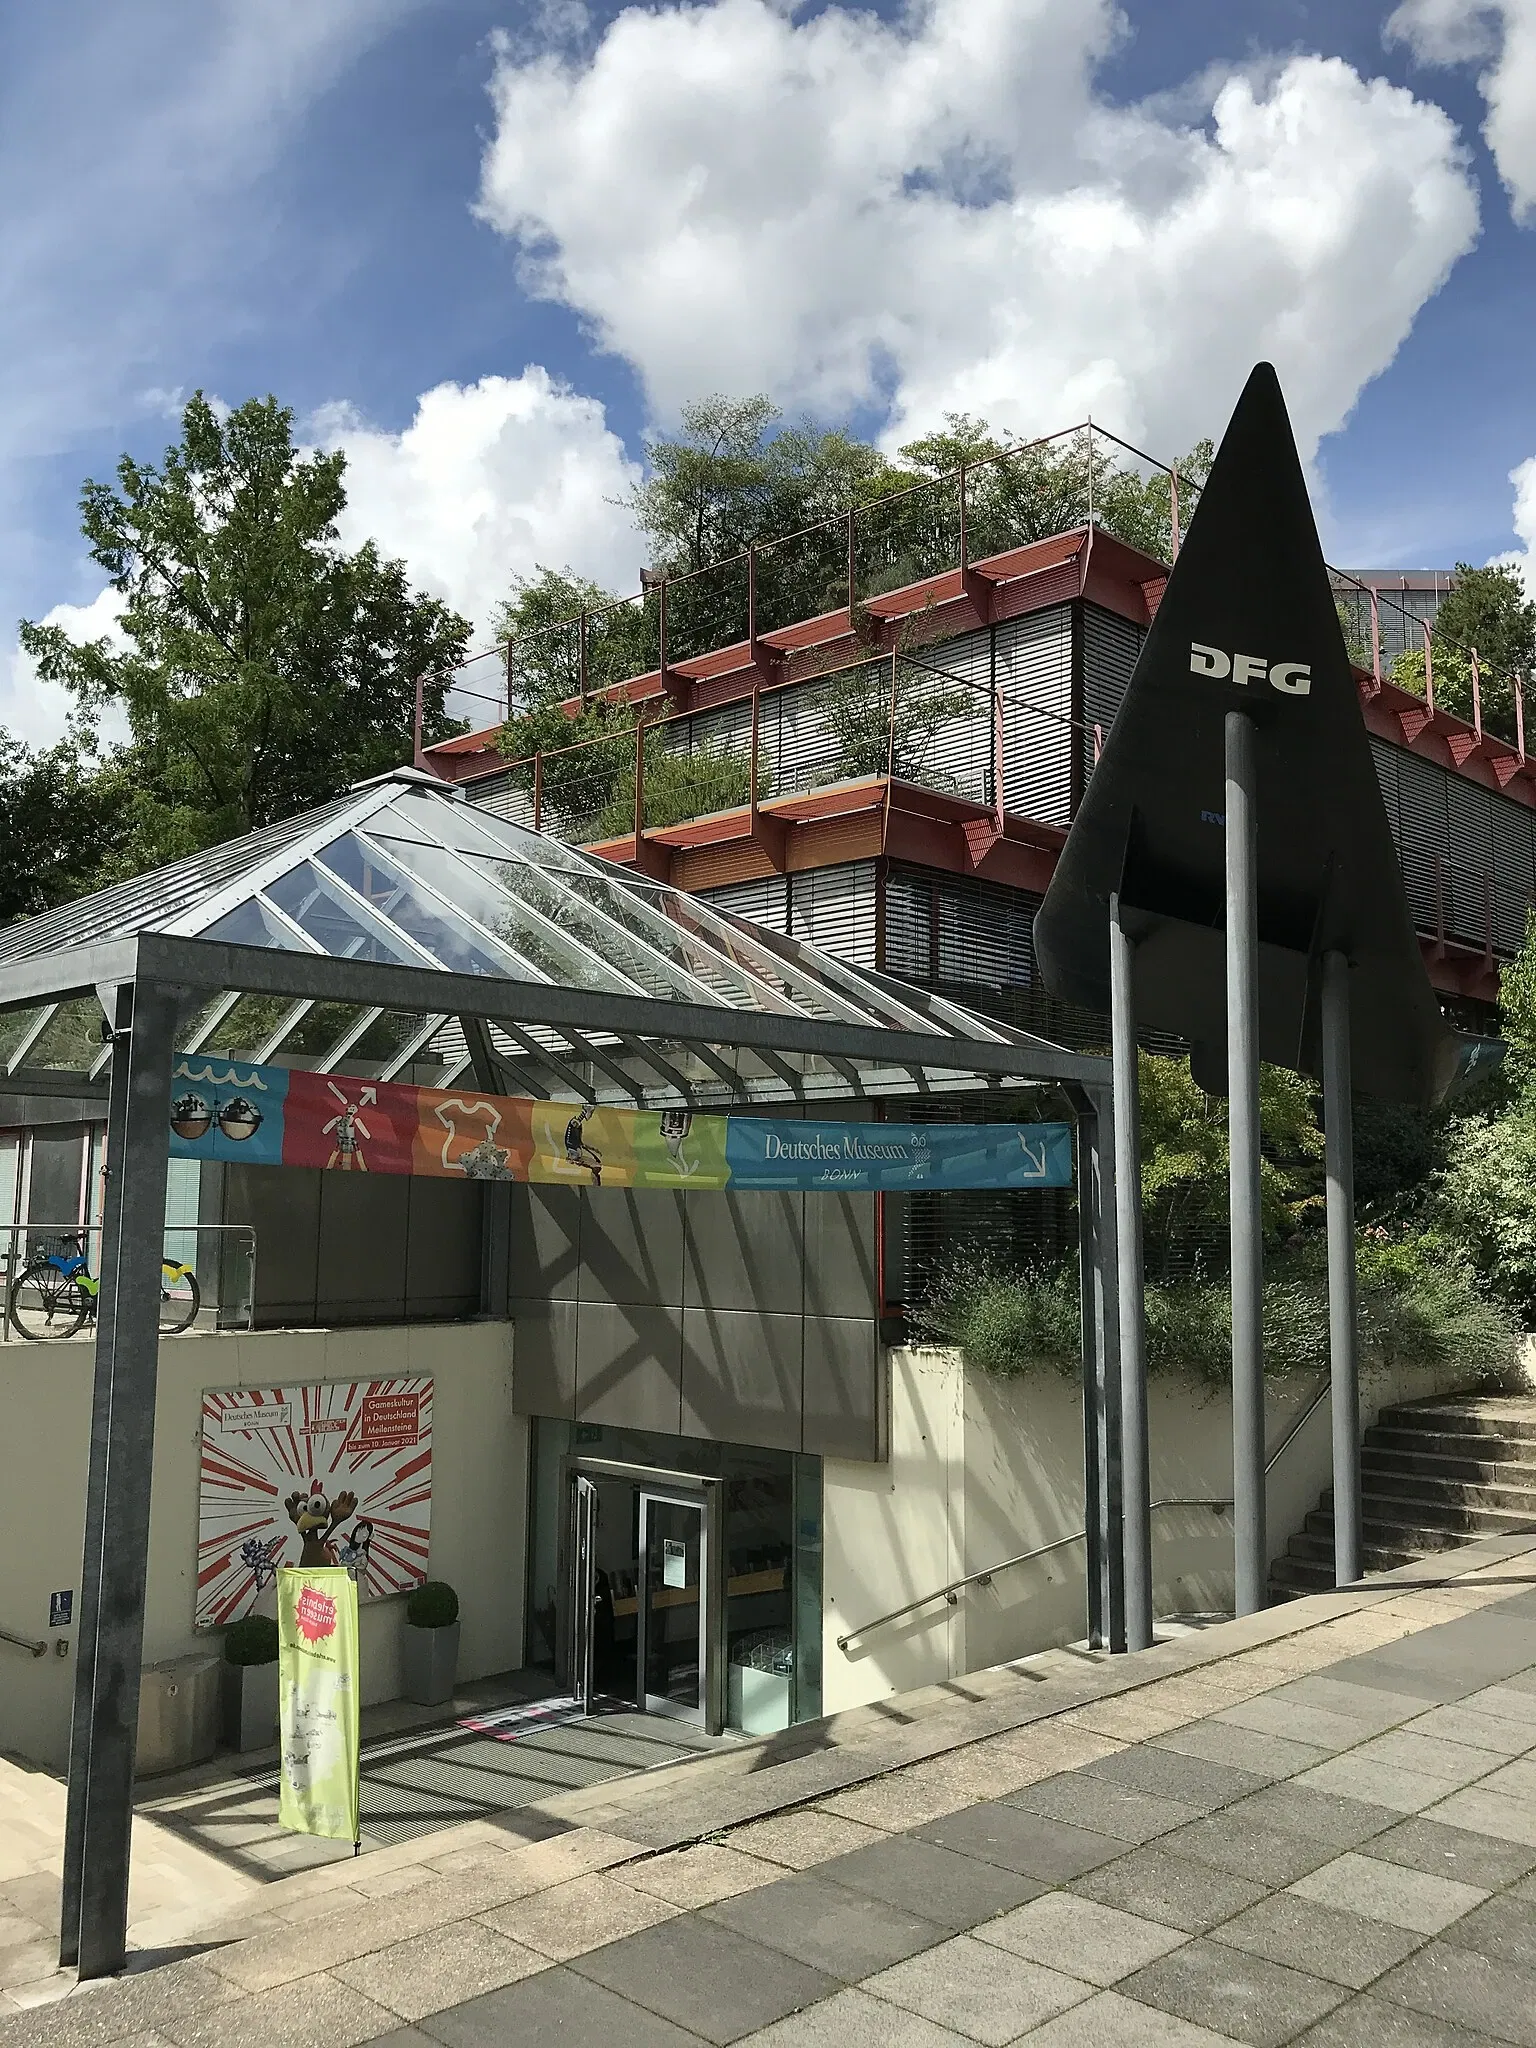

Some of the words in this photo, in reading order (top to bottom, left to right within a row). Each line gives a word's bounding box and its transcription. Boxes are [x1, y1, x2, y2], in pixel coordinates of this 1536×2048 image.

[1190, 642, 1311, 695] DFG
[765, 1134, 841, 1160] Deutsches
[843, 1136, 909, 1160] Museum
[821, 1168, 862, 1181] BONN
[368, 1398, 414, 1410] Gameskultur
[224, 1411, 253, 1422] Deutsches
[254, 1410, 279, 1419] Museum
[364, 1413, 371, 1422] in
[373, 1409, 417, 1422] Deutschland
[367, 1422, 412, 1435] Meilensteine
[358, 1441, 371, 1449] zum
[382, 1439, 401, 1448] Januar
[401, 1437, 416, 1445] 2021
